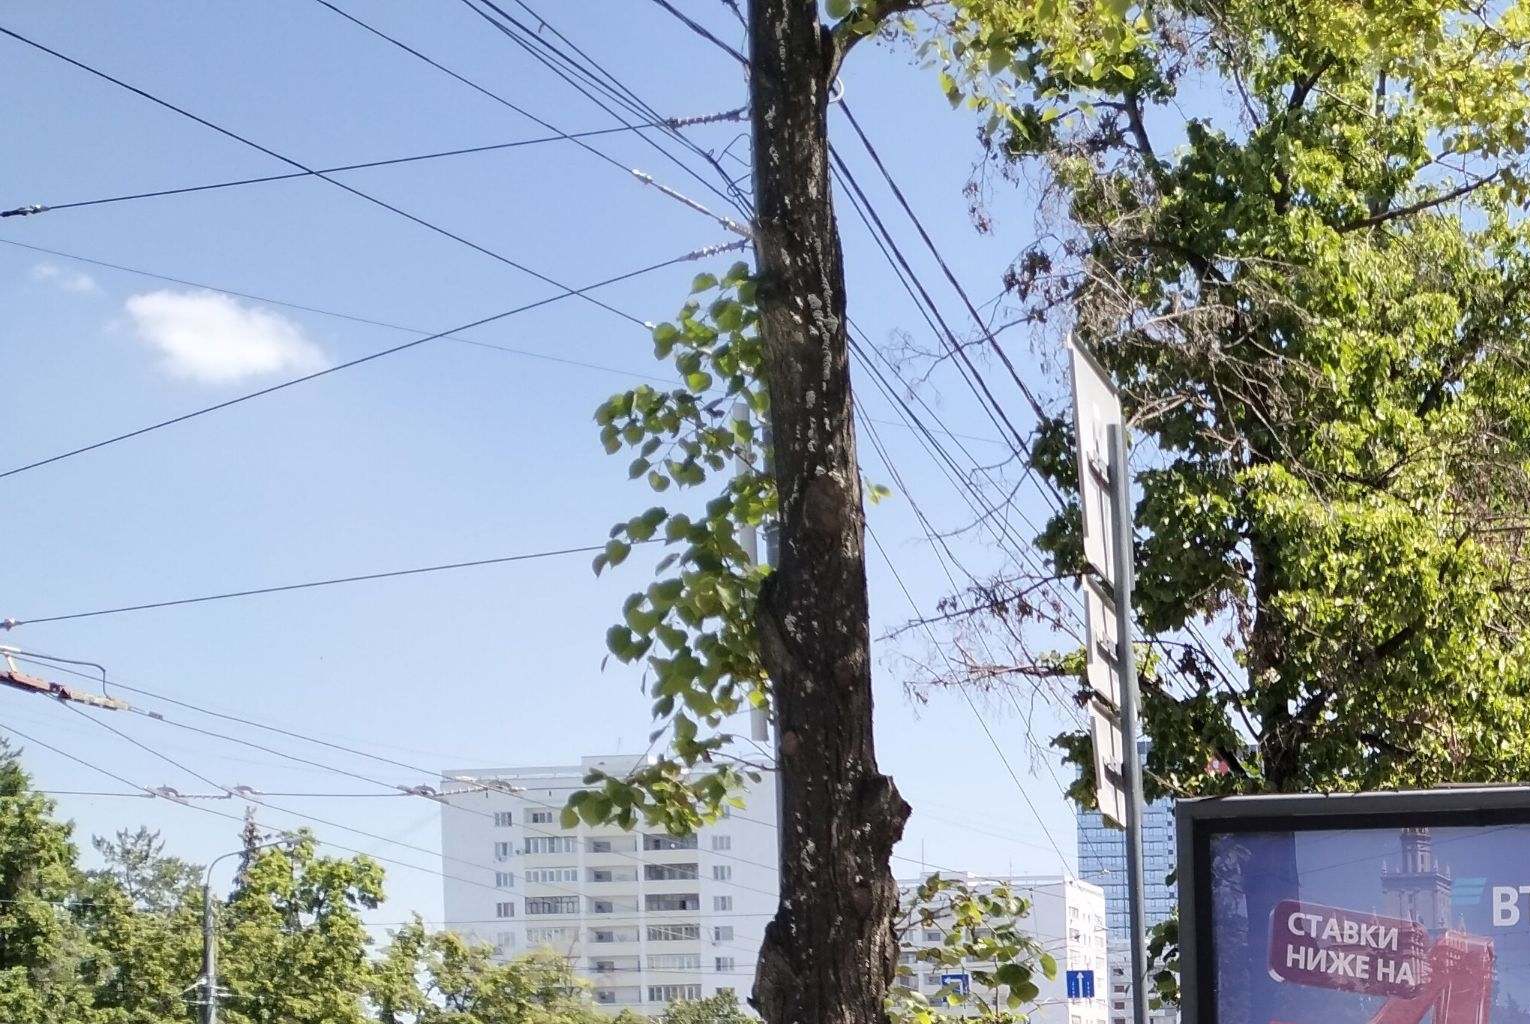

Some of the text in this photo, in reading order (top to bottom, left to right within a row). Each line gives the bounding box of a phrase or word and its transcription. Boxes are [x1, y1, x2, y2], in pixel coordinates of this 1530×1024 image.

[1287, 912, 1398, 951] СТАВКИ
[1286, 944, 1416, 986] НИЖЕ НА
